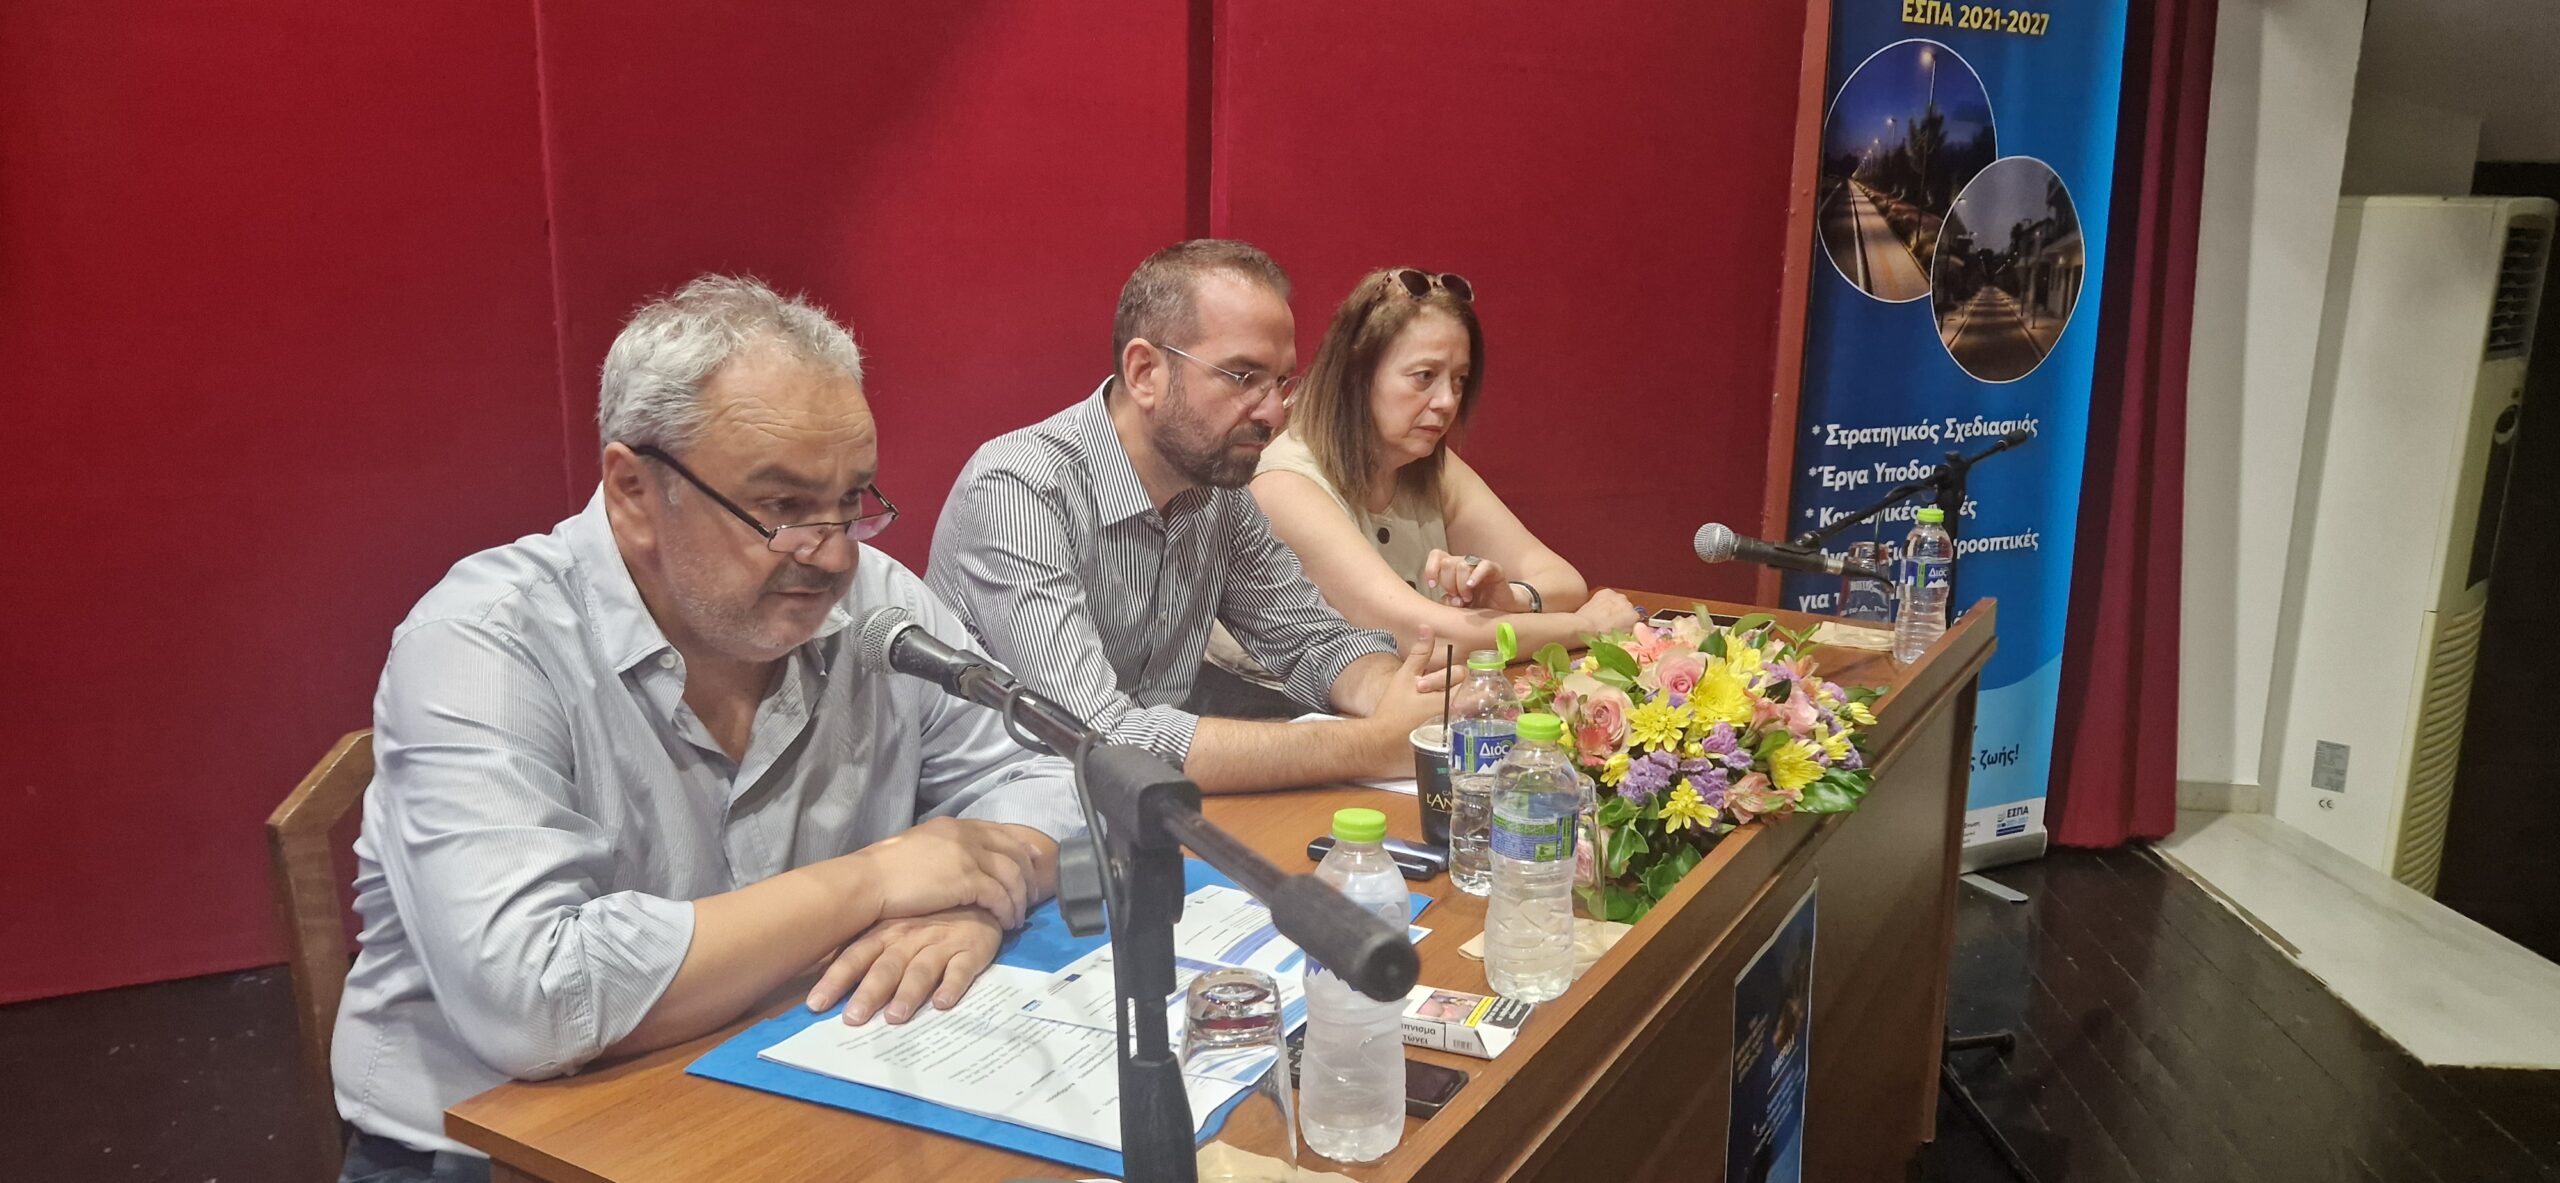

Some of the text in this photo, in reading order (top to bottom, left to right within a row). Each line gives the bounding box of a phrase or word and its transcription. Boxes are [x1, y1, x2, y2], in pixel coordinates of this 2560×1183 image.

[1902, 0, 2050, 36] ΕΣΠΑ 2021-2027
[1825, 418, 1941, 450] Στρατηγικός
[1953, 528, 2040, 559] ροοπτικές
[1799, 593, 1830, 613] για
[1980, 744, 2020, 770] ζωής!
